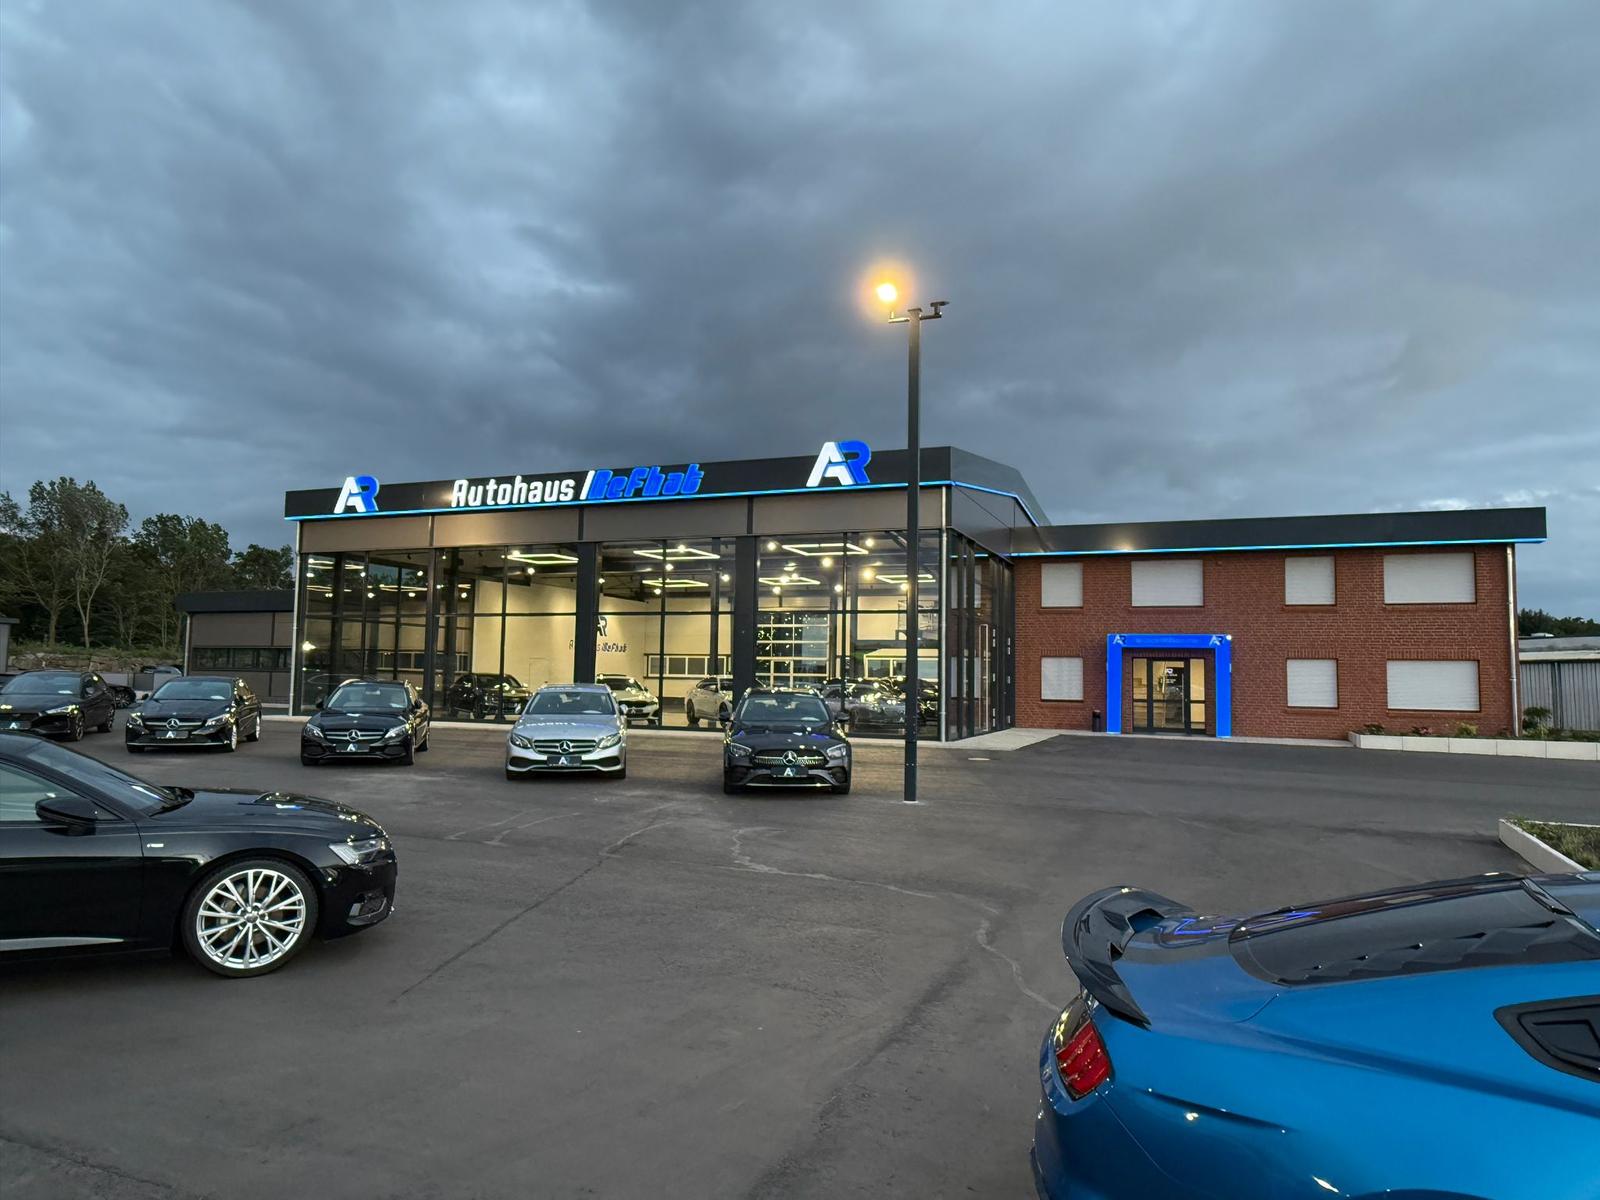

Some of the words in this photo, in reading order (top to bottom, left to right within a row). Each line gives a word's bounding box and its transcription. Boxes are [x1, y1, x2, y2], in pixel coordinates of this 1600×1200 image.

[804, 440, 871, 487] AR
[333, 475, 379, 514] AR
[451, 475, 575, 508] Autohaus
